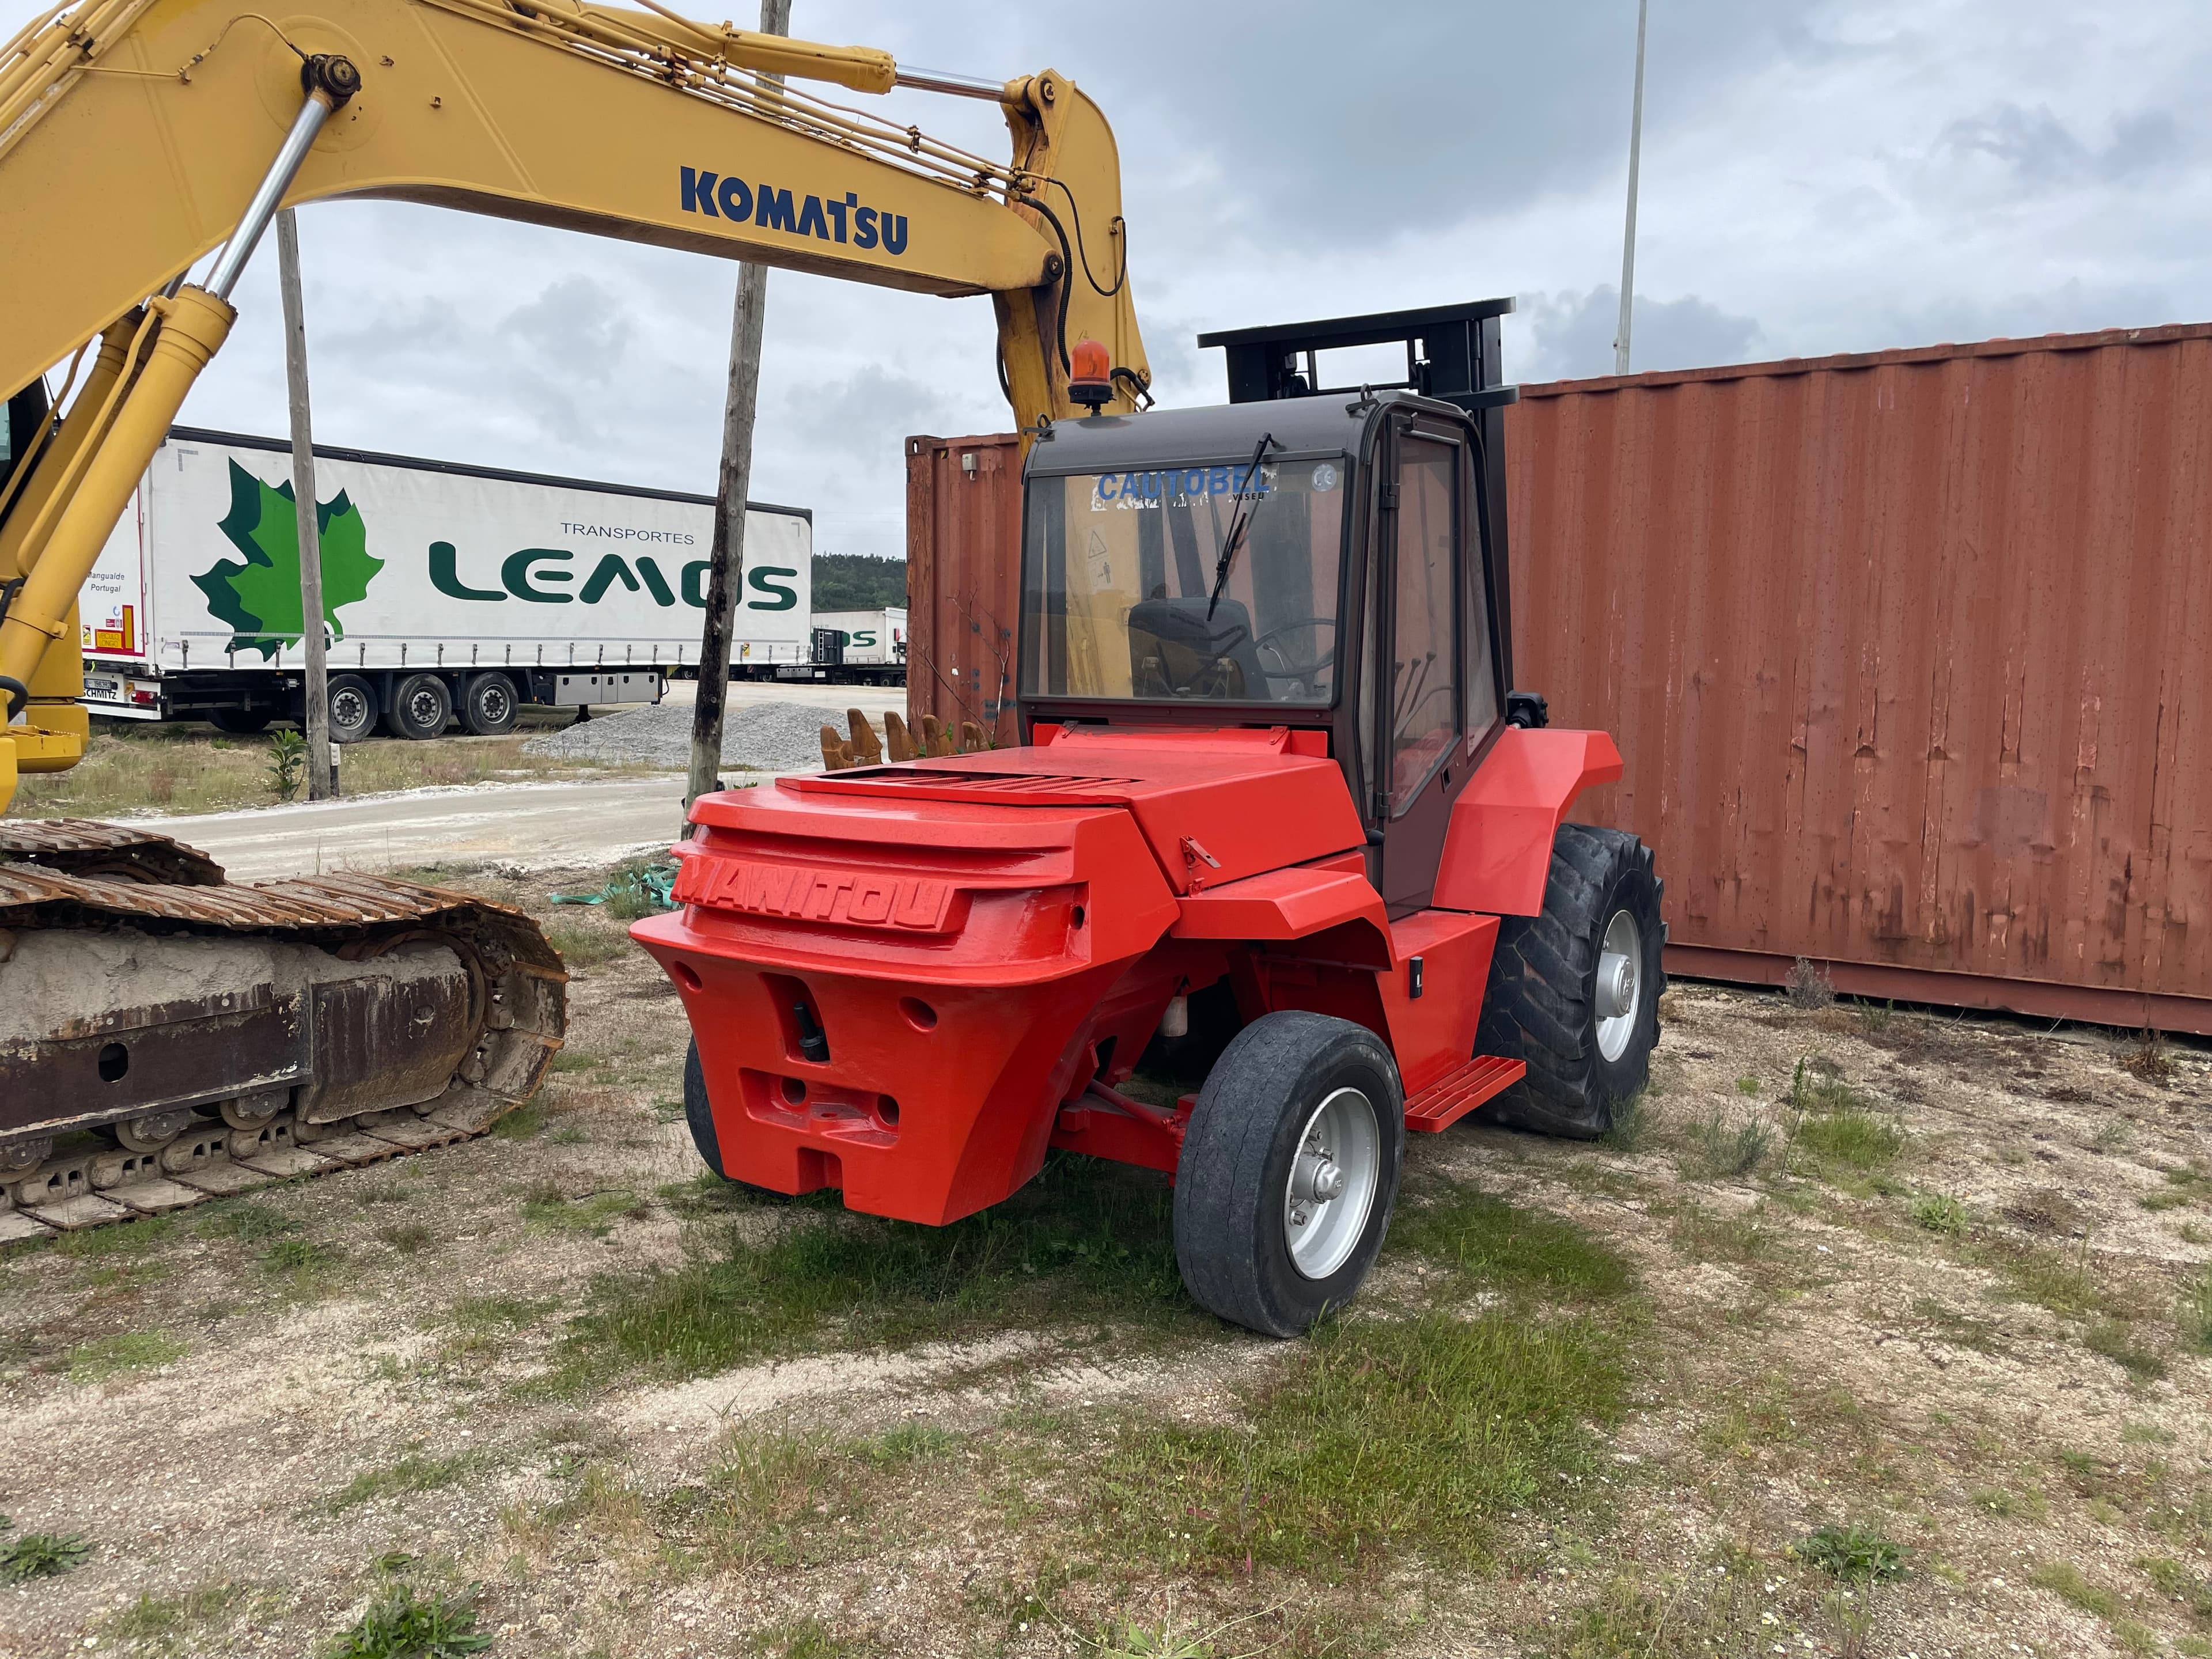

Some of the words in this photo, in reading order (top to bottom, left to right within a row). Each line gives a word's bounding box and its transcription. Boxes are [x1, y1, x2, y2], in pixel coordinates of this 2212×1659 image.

[680, 165, 908, 255] KOMATSU
[1098, 463, 1270, 501] CAUTOBEL
[1233, 492, 1264, 501] VISEU
[560, 522, 694, 545] TRANSPORTES
[90, 584, 121, 594] Portugal
[429, 541, 798, 611] LEMOS
[670, 855, 948, 930] MANITOU
